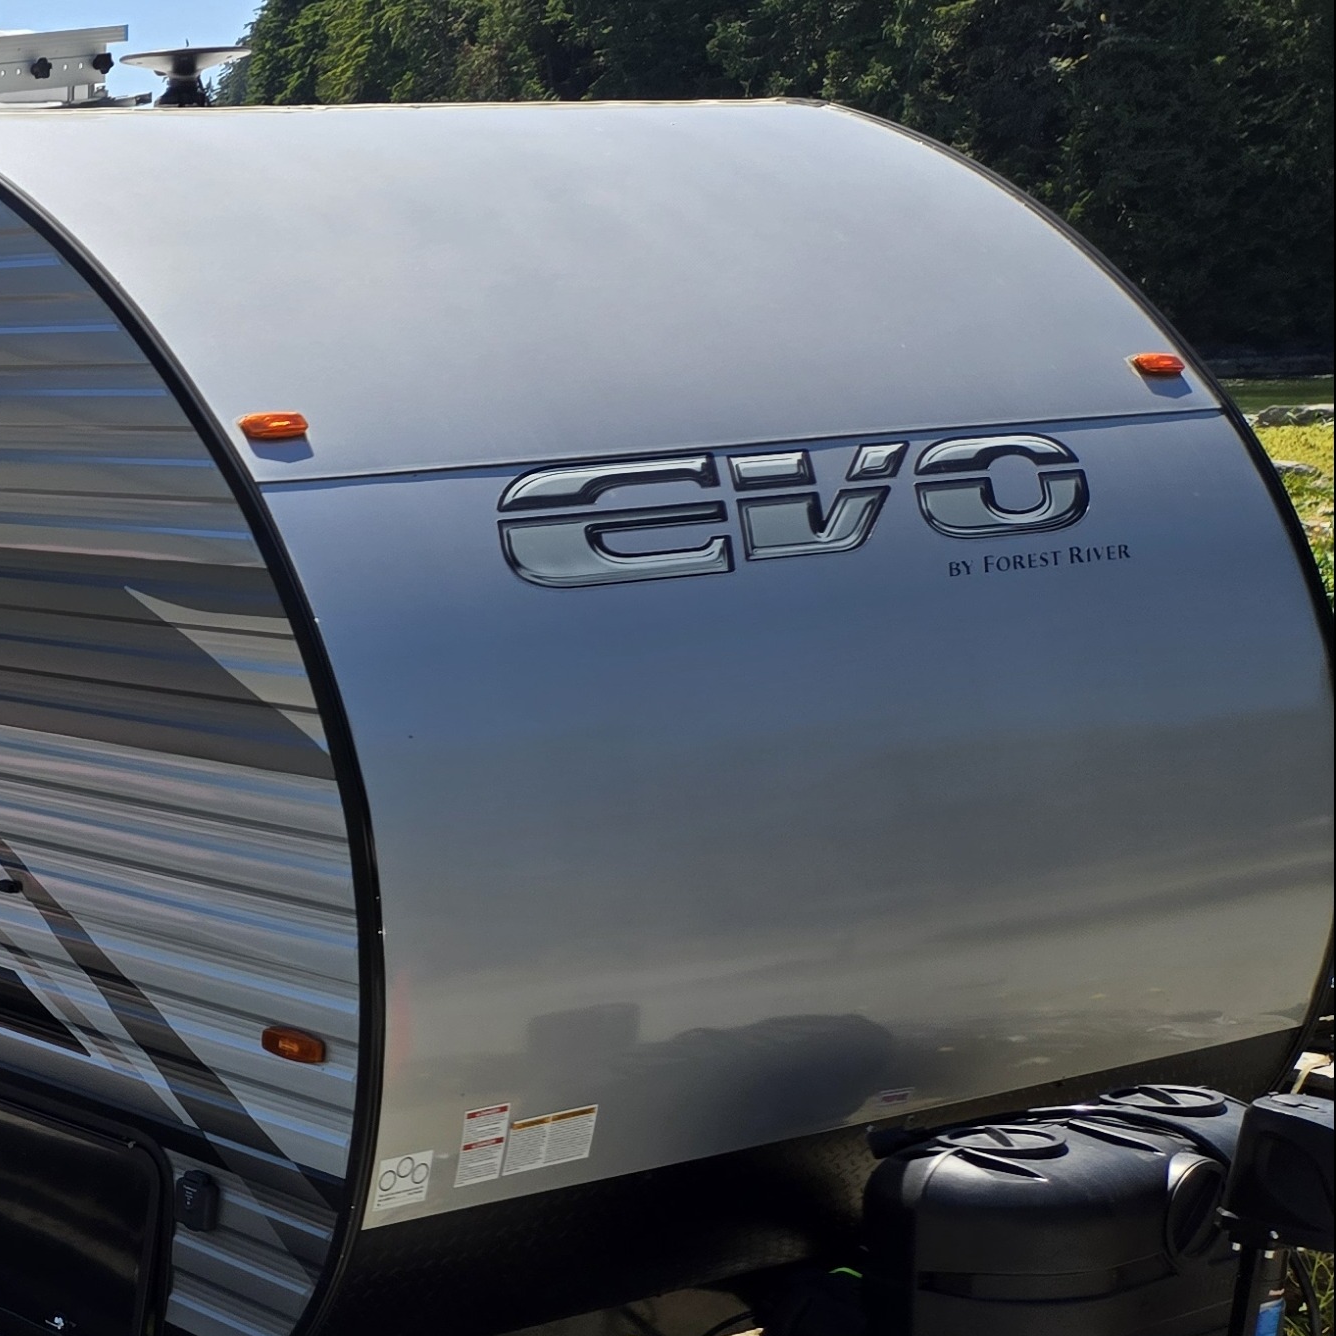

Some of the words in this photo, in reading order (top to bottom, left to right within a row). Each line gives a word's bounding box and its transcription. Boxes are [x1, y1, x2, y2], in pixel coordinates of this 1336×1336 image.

[497, 432, 1091, 588] EVO
[948, 559, 974, 577] BY
[983, 550, 1062, 574] FOREST
[1068, 543, 1131, 565] RIVER
